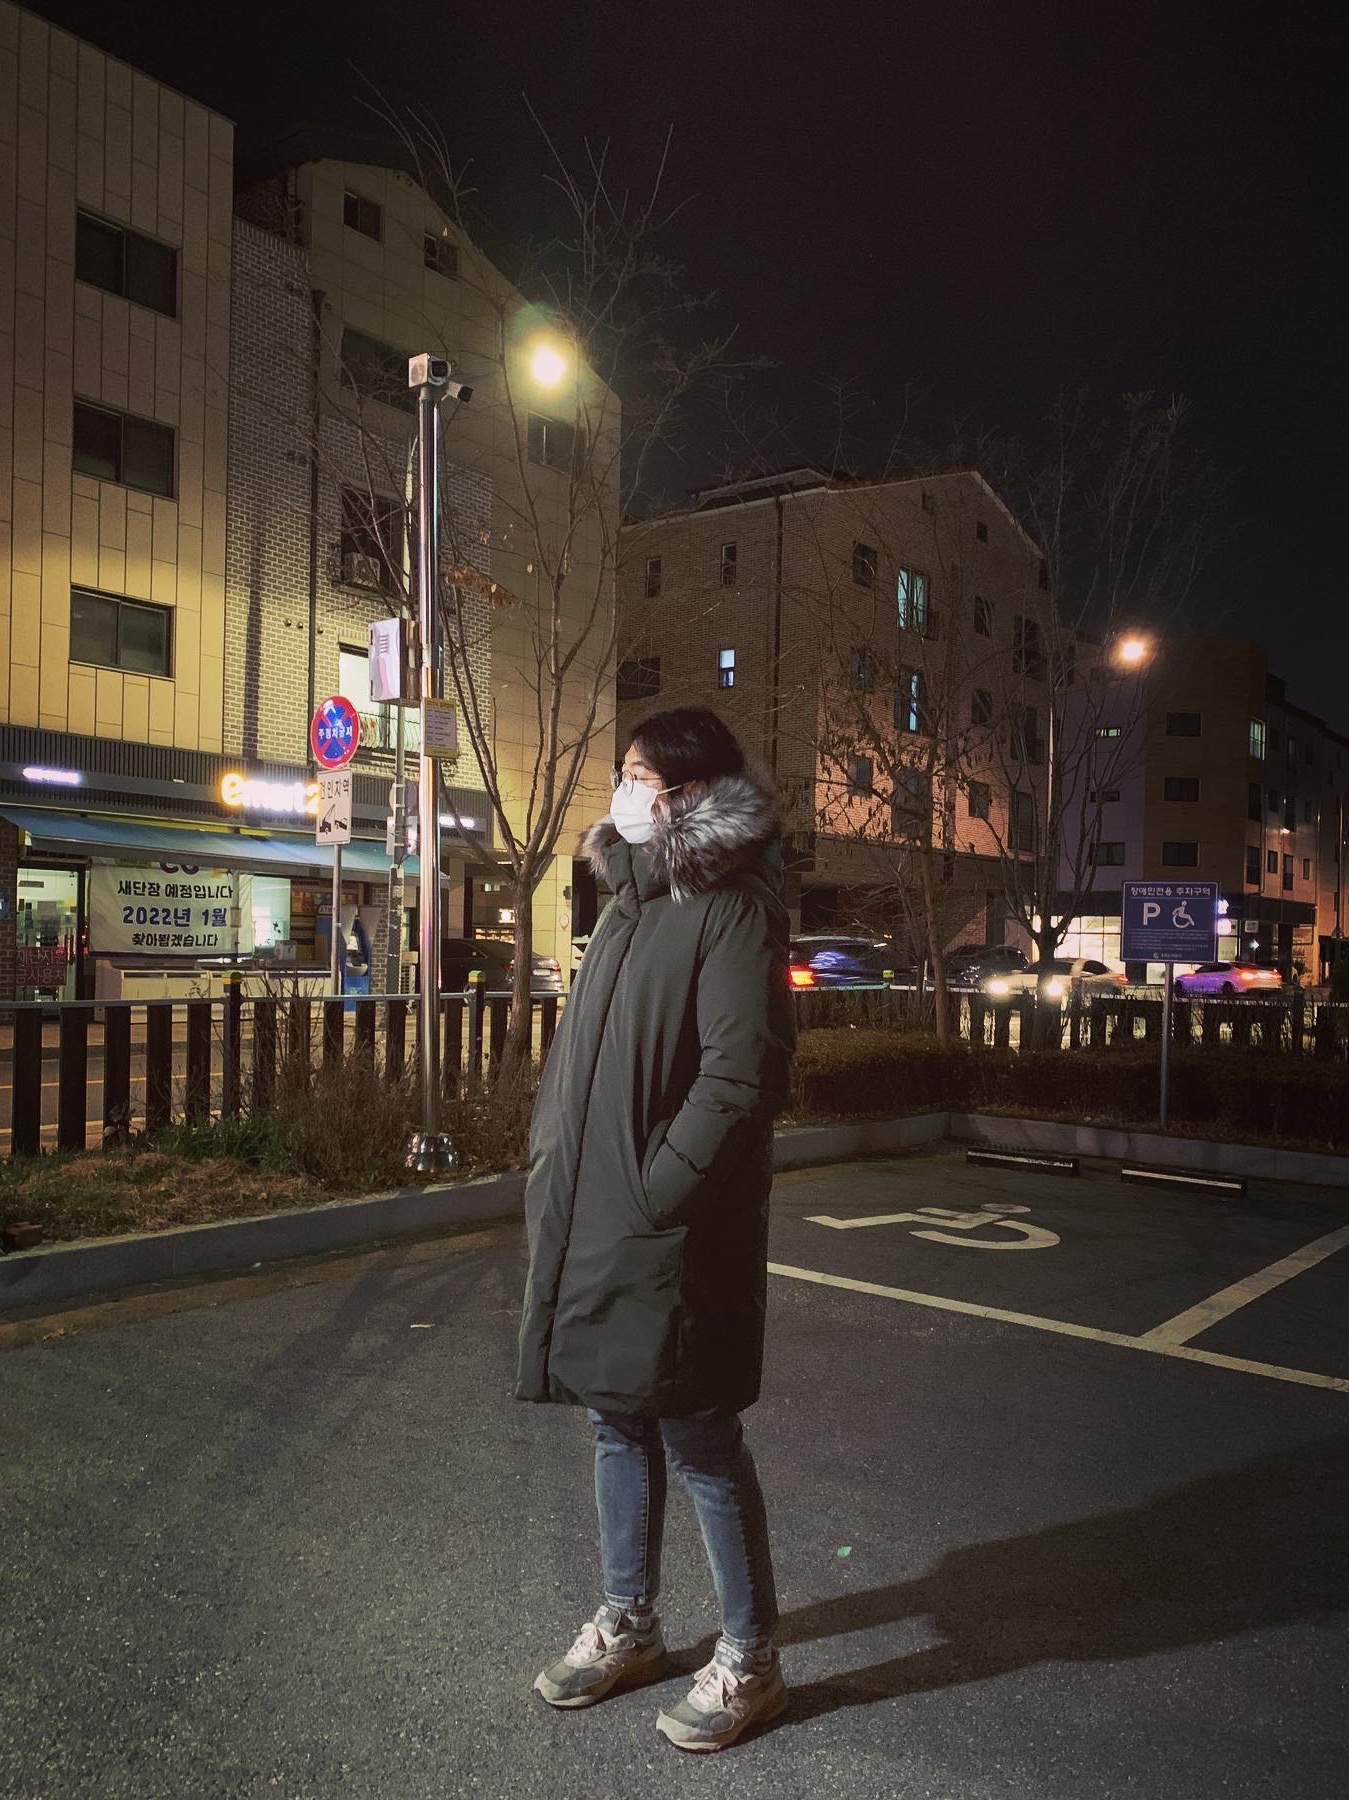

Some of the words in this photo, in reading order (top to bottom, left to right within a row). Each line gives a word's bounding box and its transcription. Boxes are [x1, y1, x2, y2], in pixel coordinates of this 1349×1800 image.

[318, 725, 352, 740] 주정차금지
[319, 777, 350, 799] 견인지역
[117, 880, 161, 897] 새단장
[164, 883, 233, 899] 예정입니다
[1130, 887, 1173, 897] 장애인전용
[1175, 887, 1211, 897] 주차구역
[122, 905, 191, 927] 2022년
[201, 907, 227, 927] 1월
[1143, 902, 1161, 926] P
[131, 932, 218, 948] 찾아뵙겠습니다
